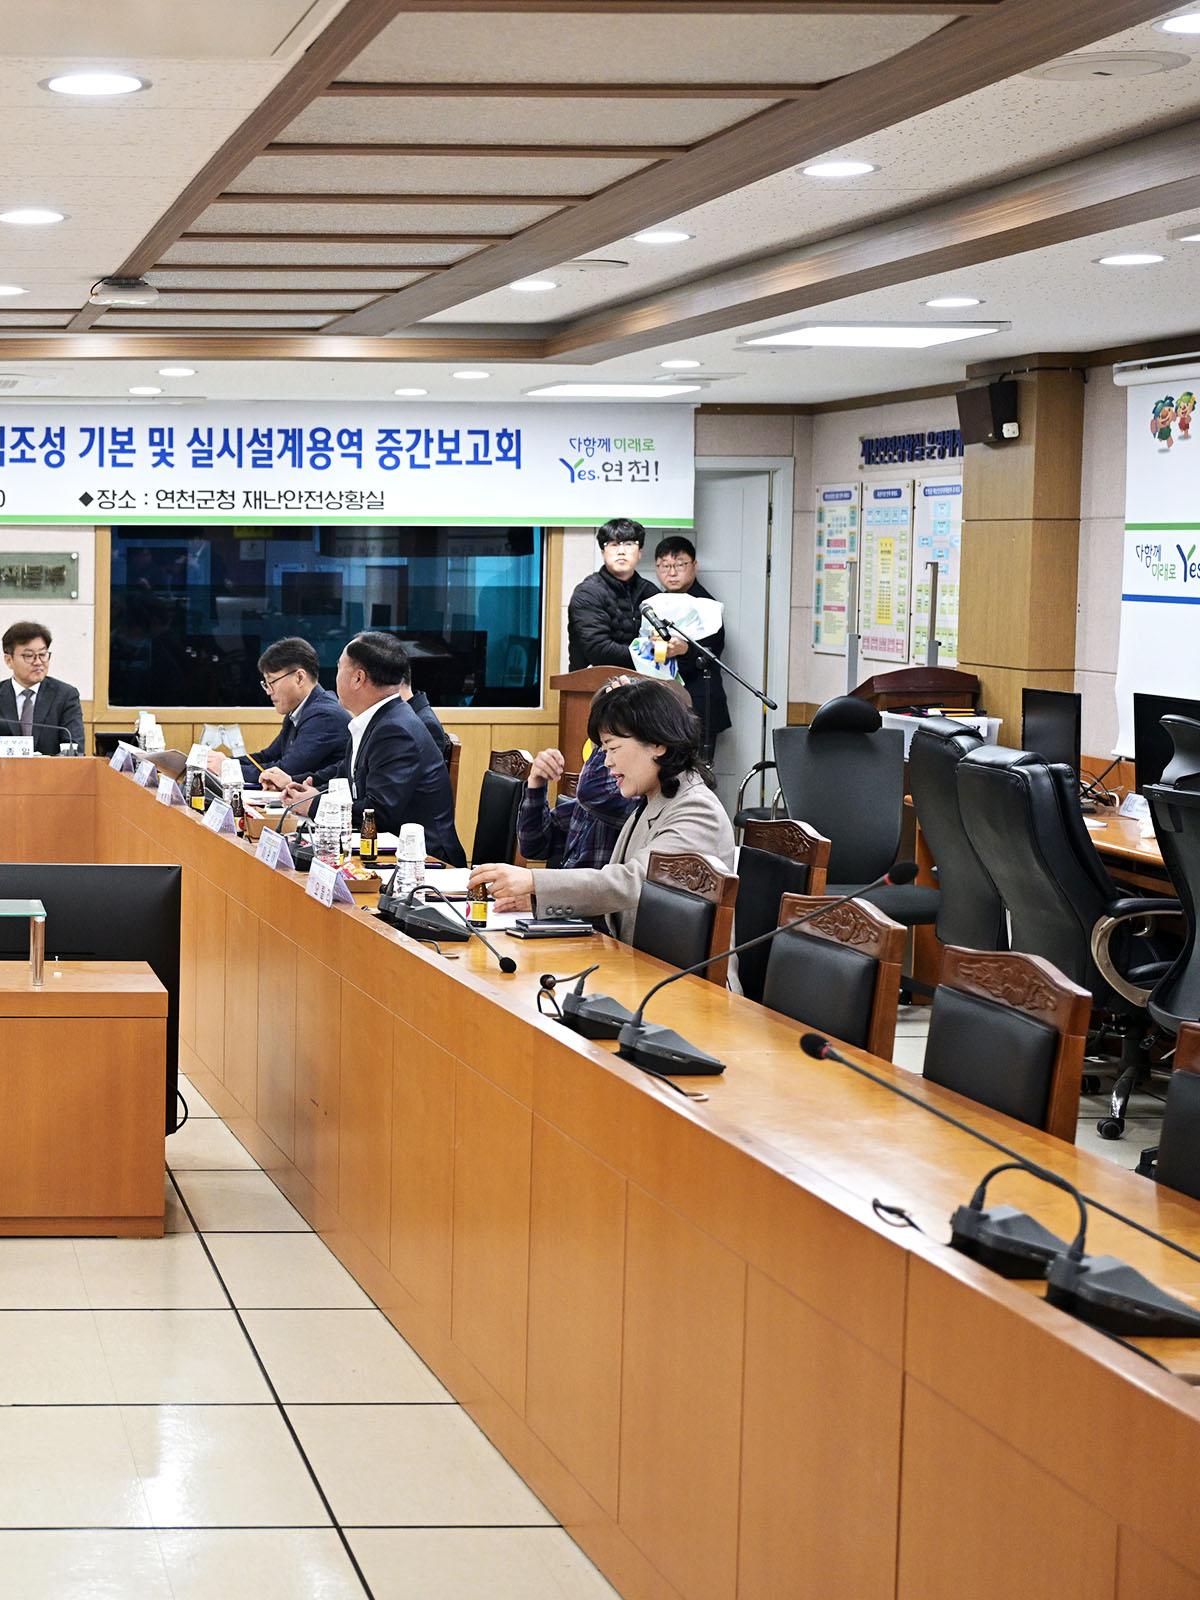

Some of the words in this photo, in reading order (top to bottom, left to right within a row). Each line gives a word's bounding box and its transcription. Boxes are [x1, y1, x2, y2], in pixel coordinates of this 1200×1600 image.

[78, 426, 137, 468] 기본
[148, 426, 175, 469] 및
[186, 426, 363, 471] 실시설계용역
[375, 427, 522, 471] 중간보고회
[568, 437, 611, 458] 다함께
[613, 437, 656, 453] 미래로
[97, 489, 137, 510] 장소
[155, 489, 236, 510] 연천군청
[242, 489, 385, 511] 재난안전상황실
[1136, 544, 1161, 568] 다함께
[1152, 563, 1176, 581] 미래로
